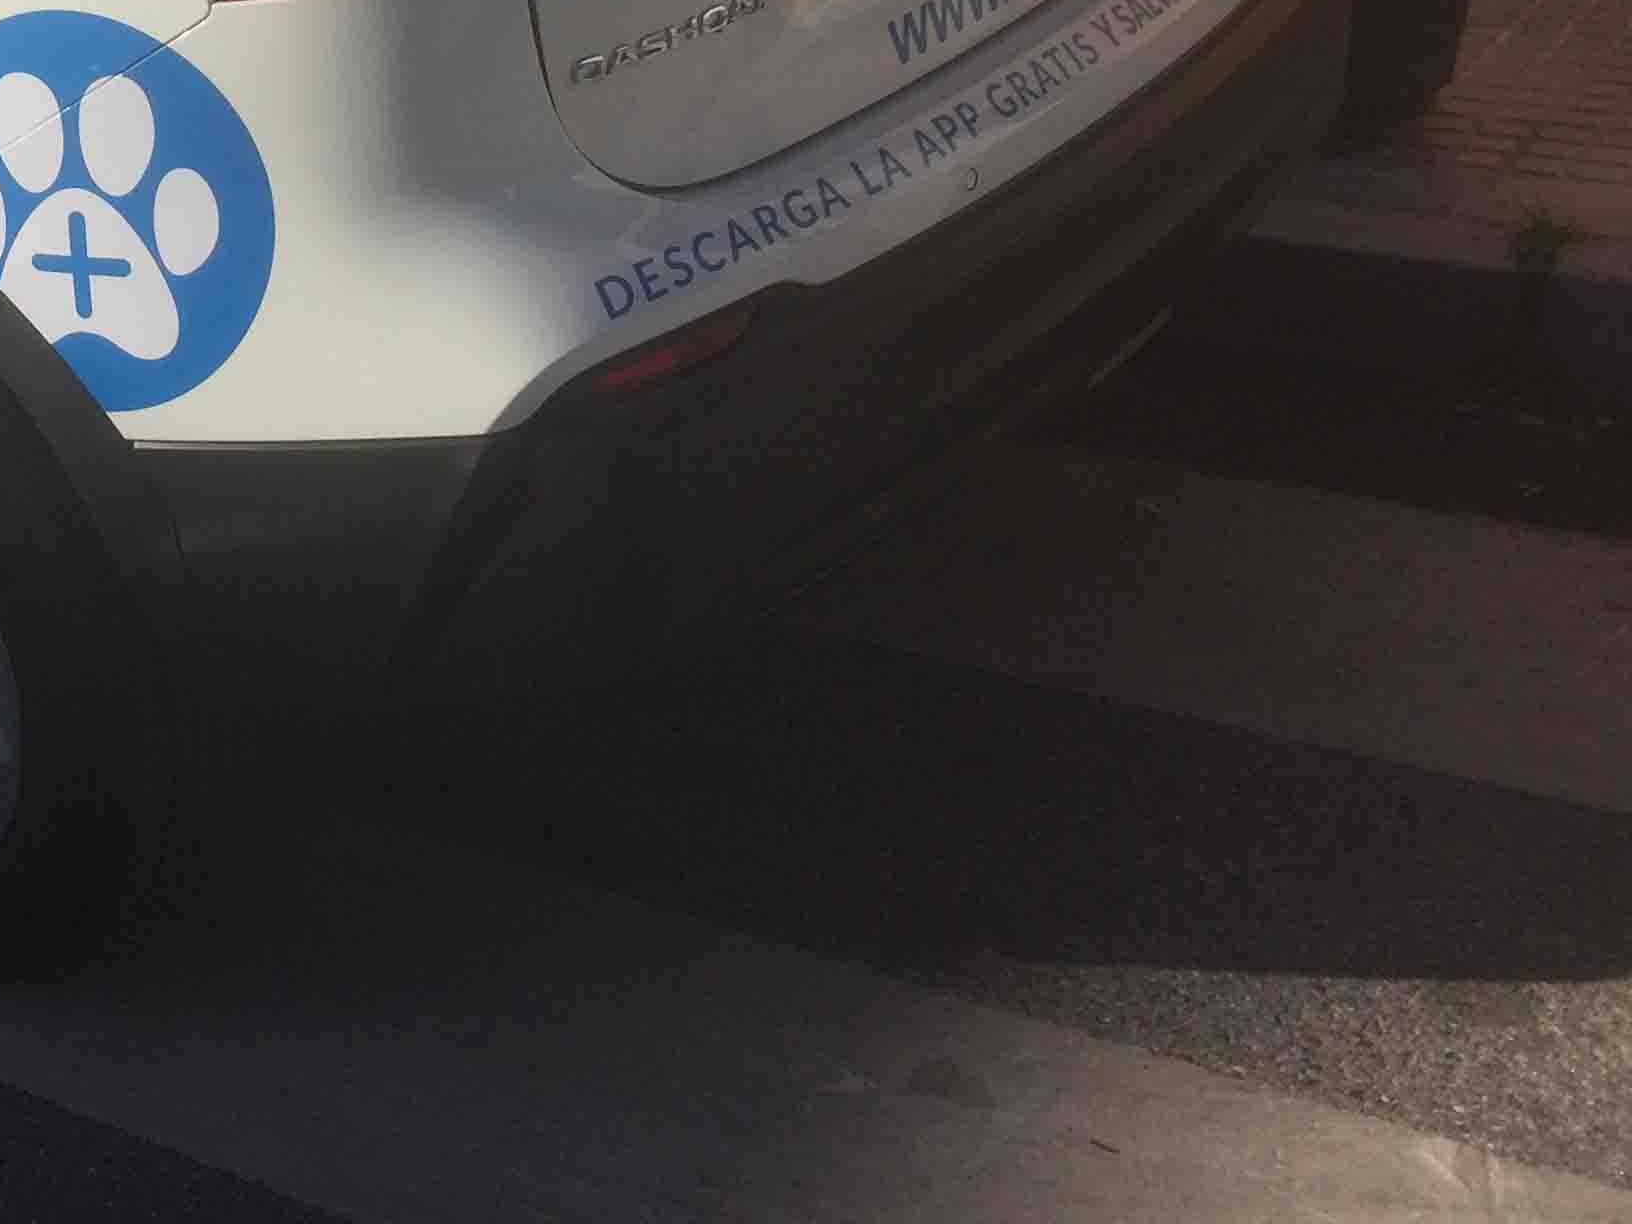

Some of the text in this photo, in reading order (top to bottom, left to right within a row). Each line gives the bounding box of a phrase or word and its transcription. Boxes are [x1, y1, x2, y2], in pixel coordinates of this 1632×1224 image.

[594, 176, 852, 321] DESCARGA
[849, 147, 913, 197] LA
[913, 102, 980, 167] APP
[985, 31, 1100, 119] GRATIS
[1088, 14, 1121, 48] Y
